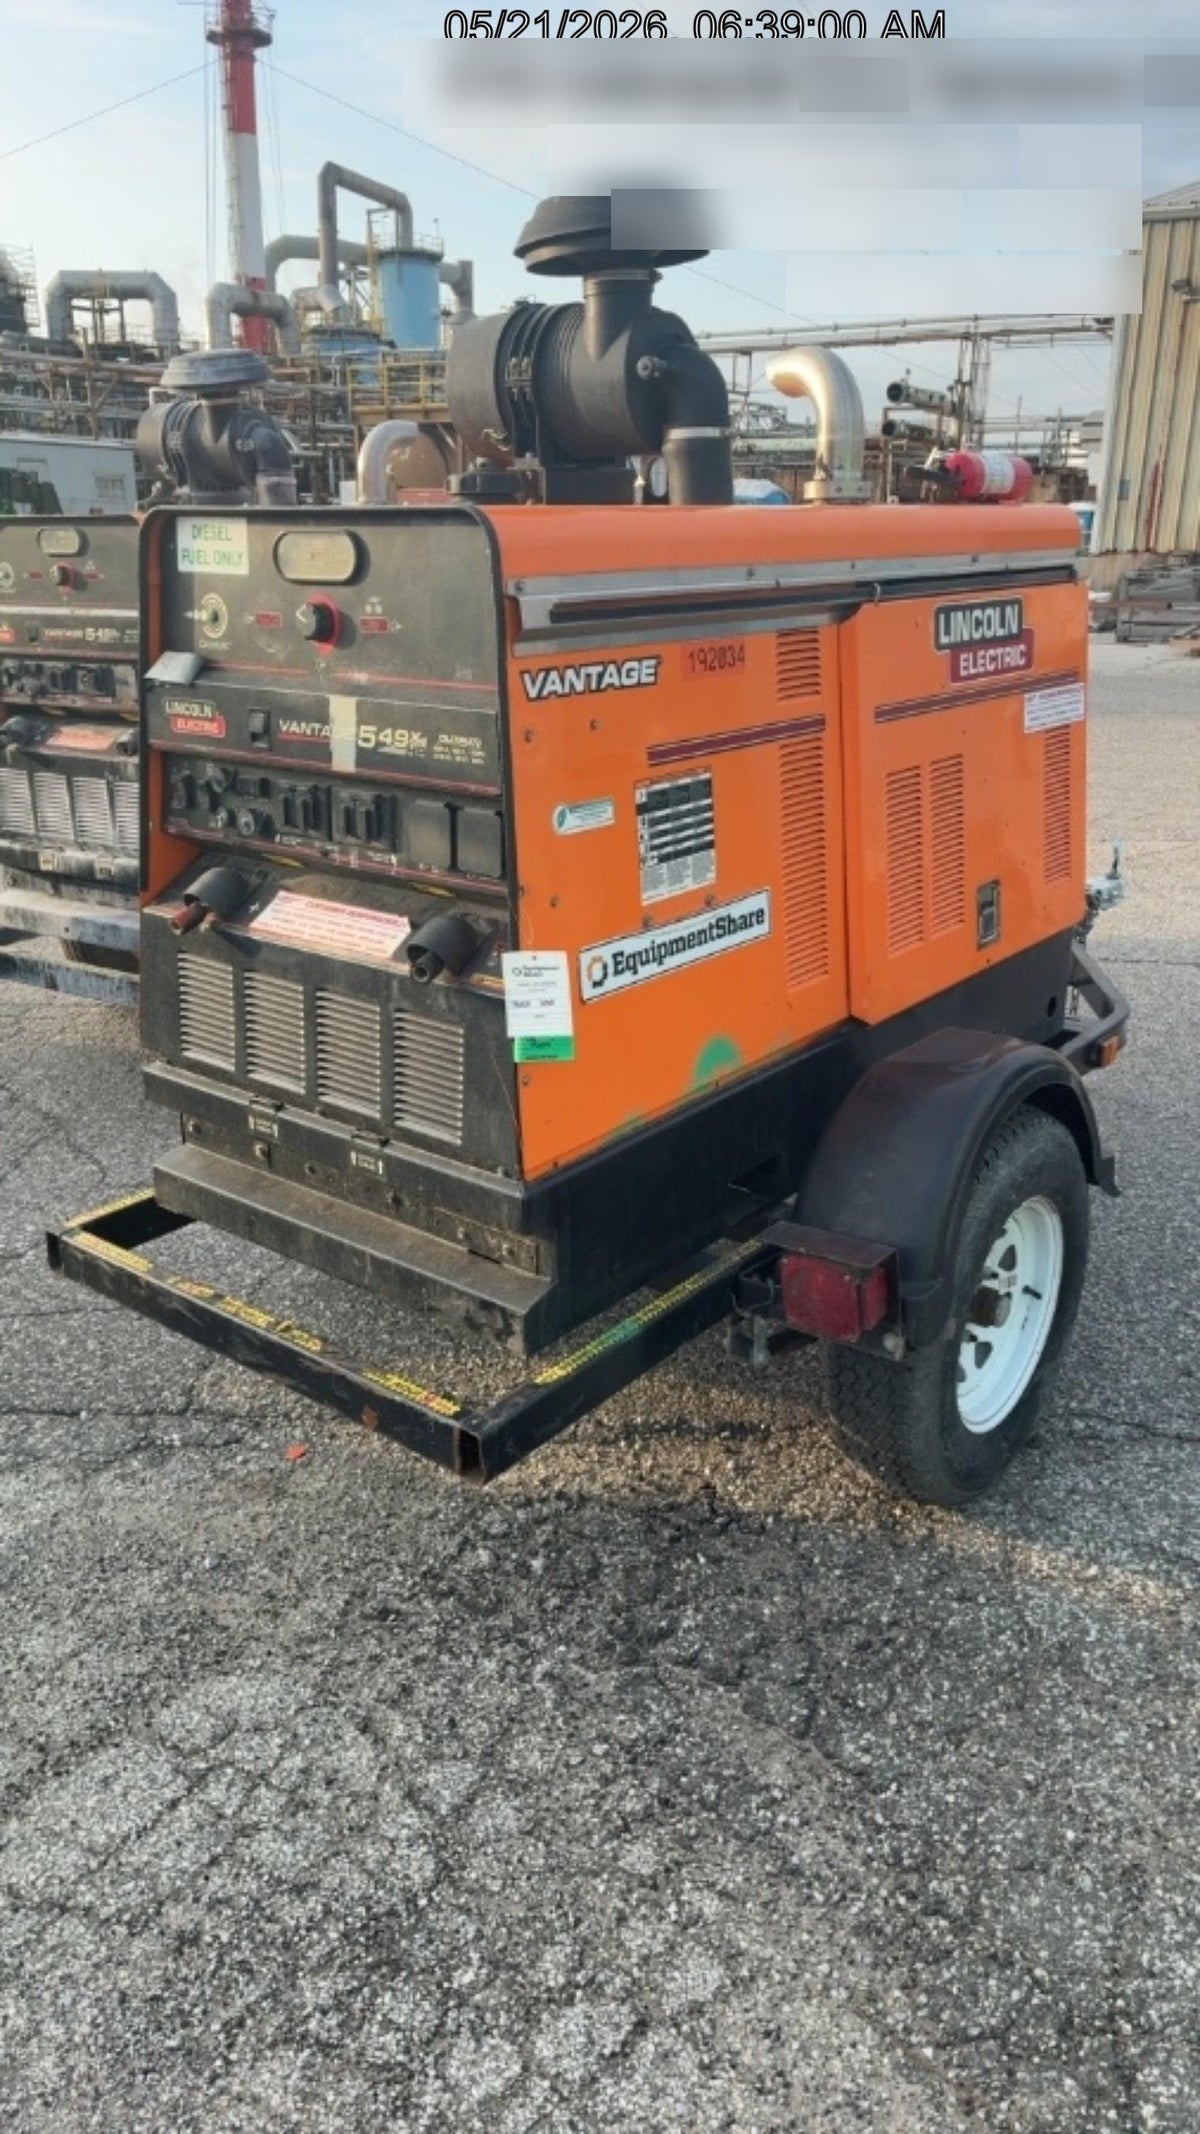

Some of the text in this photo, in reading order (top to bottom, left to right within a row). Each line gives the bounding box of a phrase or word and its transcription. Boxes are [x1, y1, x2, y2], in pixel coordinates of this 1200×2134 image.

[191, 524, 232, 541] DIESEL
[182, 548, 244, 567] FUEL ONLY
[938, 604, 1018, 644] LINCOLN
[689, 645, 746, 673] 192034
[960, 645, 1027, 676] ELECTRIC
[521, 656, 659, 700] VANTAGE
[165, 701, 212, 718] LINCOLN
[612, 907, 764, 976] EquipmentShare
